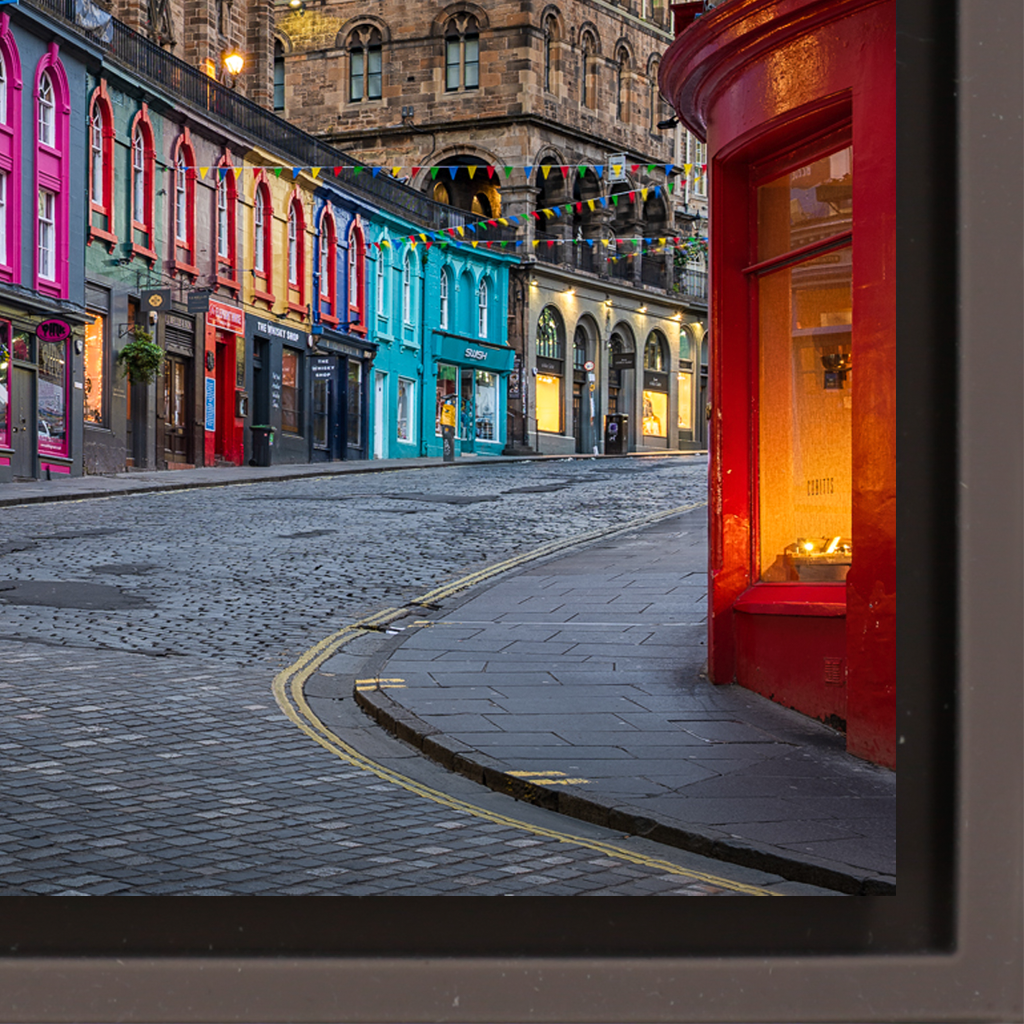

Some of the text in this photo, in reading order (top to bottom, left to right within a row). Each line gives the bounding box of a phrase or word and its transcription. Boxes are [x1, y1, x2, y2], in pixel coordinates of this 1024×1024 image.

[257, 321, 267, 334] THE
[267, 324, 287, 339] WHISKY
[287, 330, 299, 342] SHOP
[807, 477, 834, 496] CUBITTS
